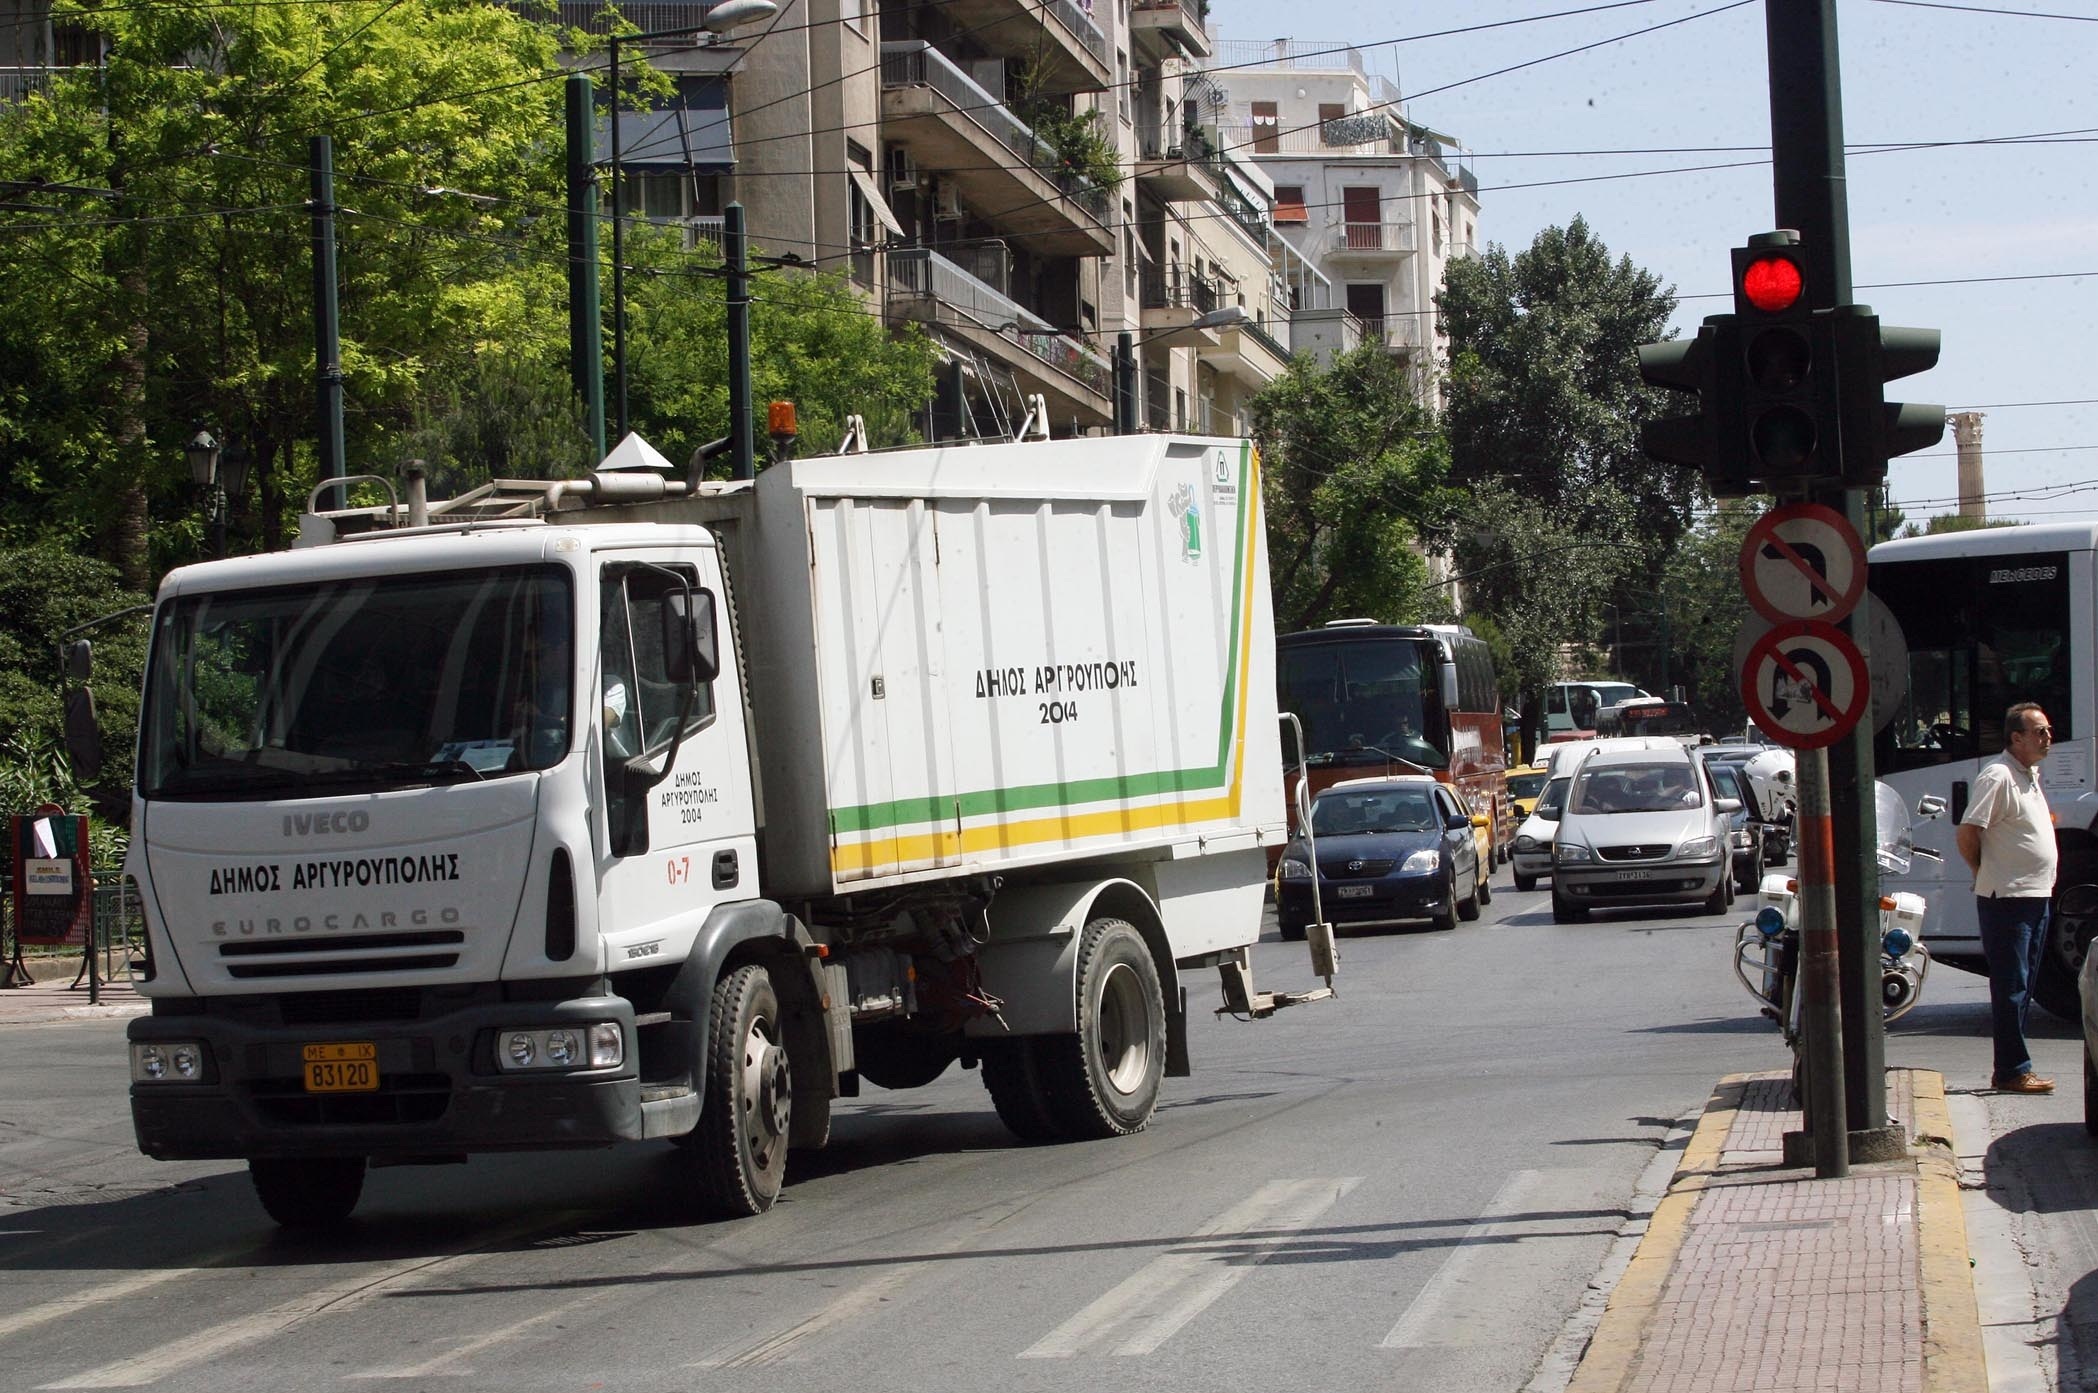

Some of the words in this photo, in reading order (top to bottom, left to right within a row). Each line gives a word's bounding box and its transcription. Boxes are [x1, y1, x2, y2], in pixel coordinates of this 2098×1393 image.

[1989, 566, 2057, 583] MERCEDES
[675, 771, 701, 788] ΔΗΜΟΣ
[661, 788, 718, 808] ΑΡΓΥΡΟΥΠΟΛΗΣ
[283, 810, 370, 837] IVECO
[210, 865, 281, 895] ΔΗΜΟΣ
[293, 854, 460, 890] ΑΡΓΥΡΟΥΠΟΛΗΣ
[212, 907, 460, 936] EUROCARGO
[312, 1063, 369, 1087] 83120
